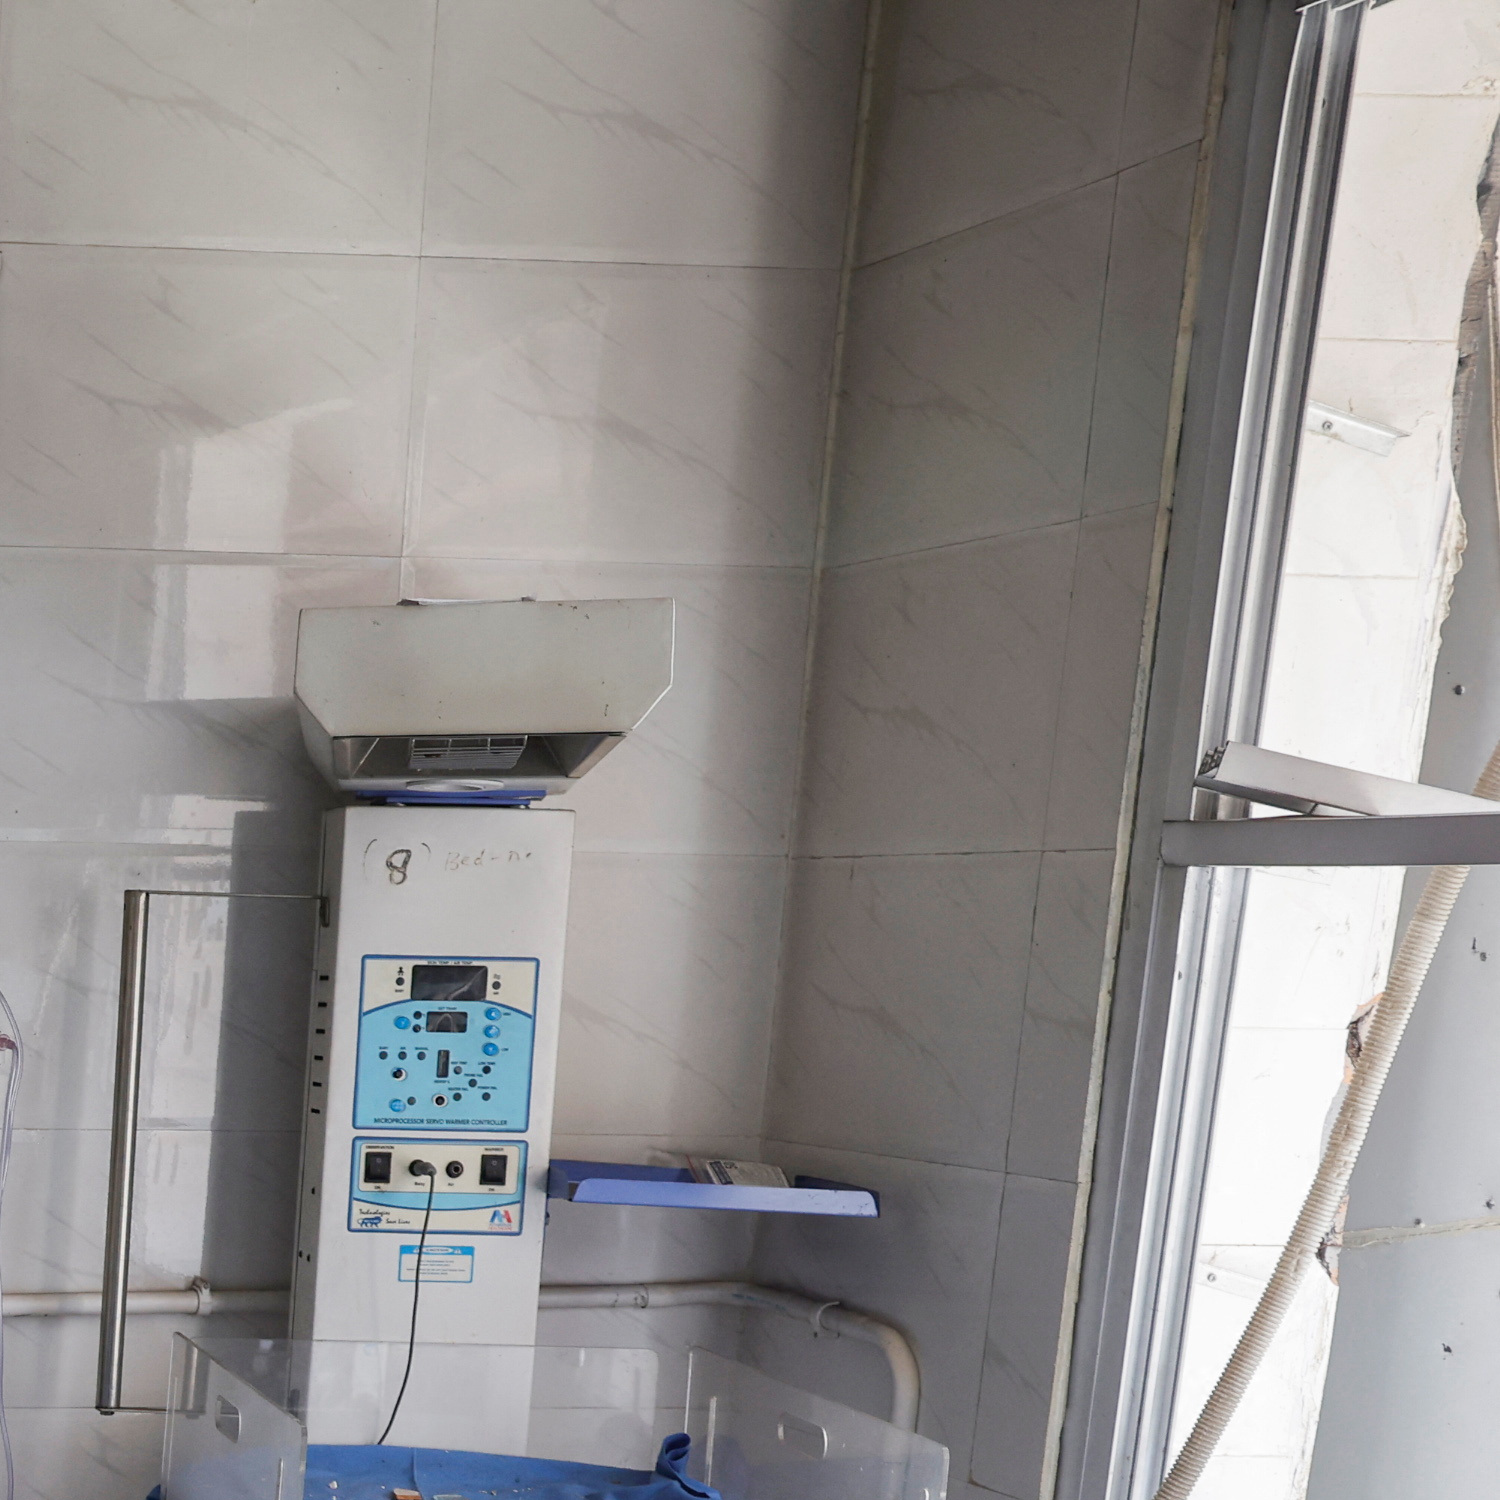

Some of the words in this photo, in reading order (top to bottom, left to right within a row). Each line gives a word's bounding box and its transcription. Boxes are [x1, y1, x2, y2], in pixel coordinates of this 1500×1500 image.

[373, 1117, 425, 1125] MICROPROCESSOR
[445, 1118, 470, 1126] WARMER
[359, 1208, 390, 1217] Technologies
